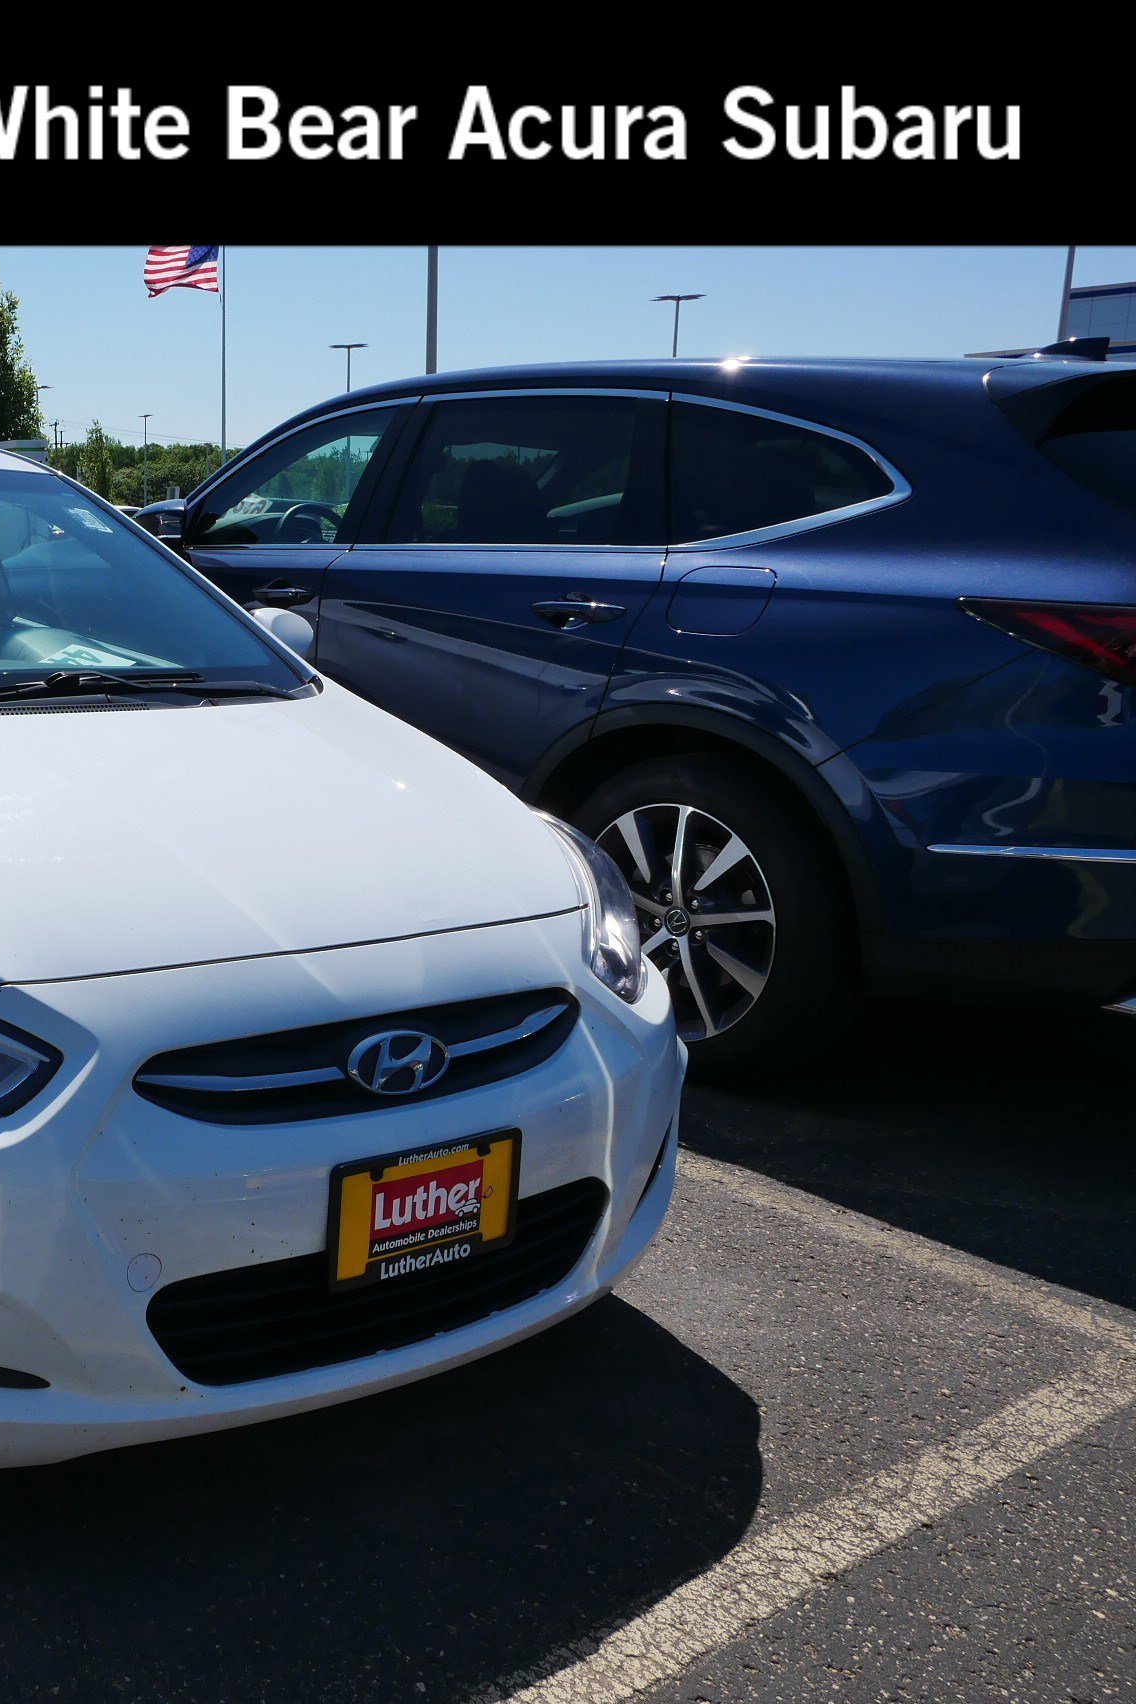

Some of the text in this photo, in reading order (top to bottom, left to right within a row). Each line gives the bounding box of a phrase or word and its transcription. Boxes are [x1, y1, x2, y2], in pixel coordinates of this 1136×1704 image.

[398, 1143, 469, 1166] LutherAuto.com
[374, 1177, 481, 1231] Luther
[372, 1219, 477, 1254] Automobile Dealerships
[380, 1243, 471, 1280] LutherAuto
